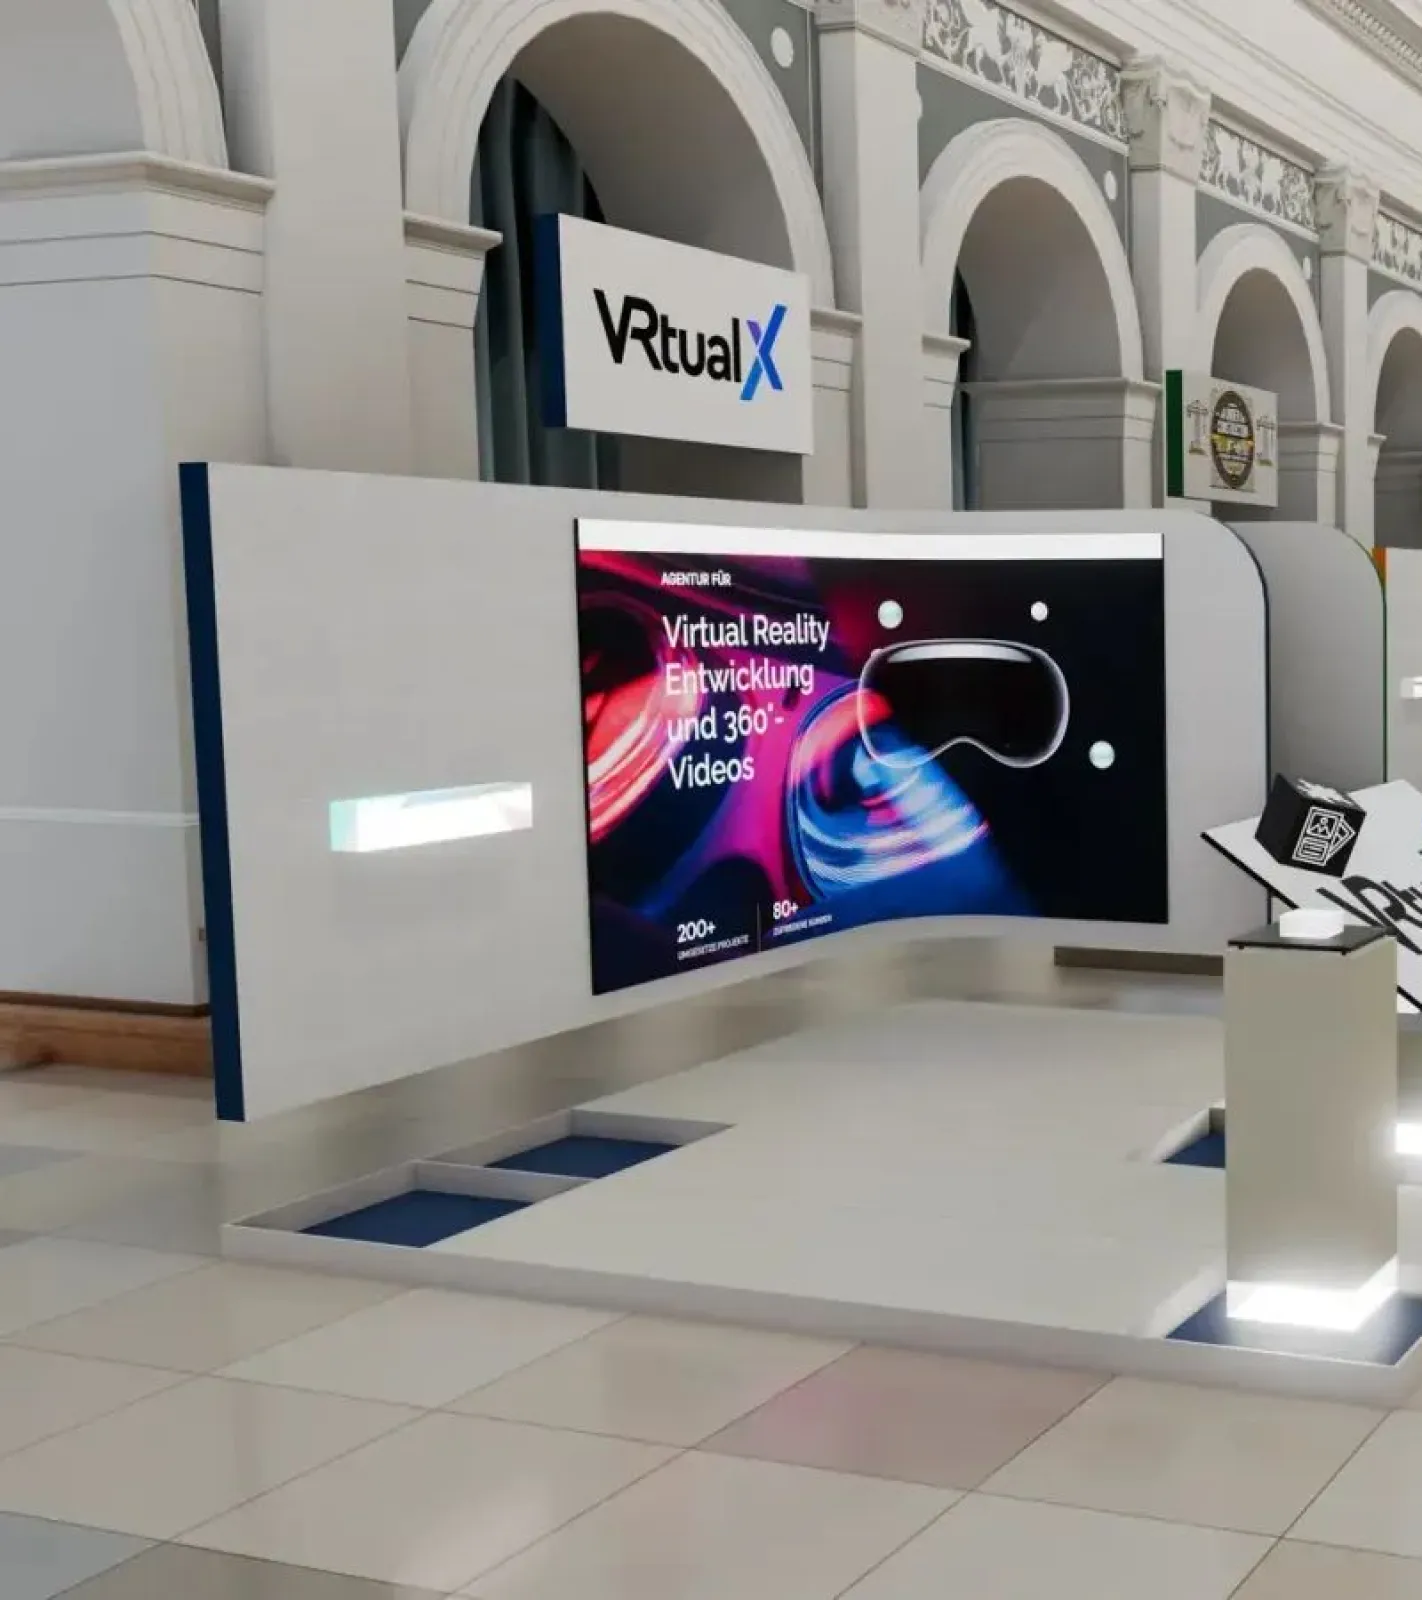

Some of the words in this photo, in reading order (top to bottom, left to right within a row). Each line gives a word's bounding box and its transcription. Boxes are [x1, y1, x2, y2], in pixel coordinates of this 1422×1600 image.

[593, 287, 788, 401] VRtualX
[660, 572, 709, 586] AGENTUR
[711, 570, 731, 586] FÜR
[661, 613, 749, 648] Virtual
[752, 613, 831, 652] Reality
[665, 657, 815, 696] Entwicklung
[667, 706, 718, 742] und
[667, 752, 755, 790] Videos
[772, 899, 799, 920] 80+
[676, 918, 716, 943] 200+
